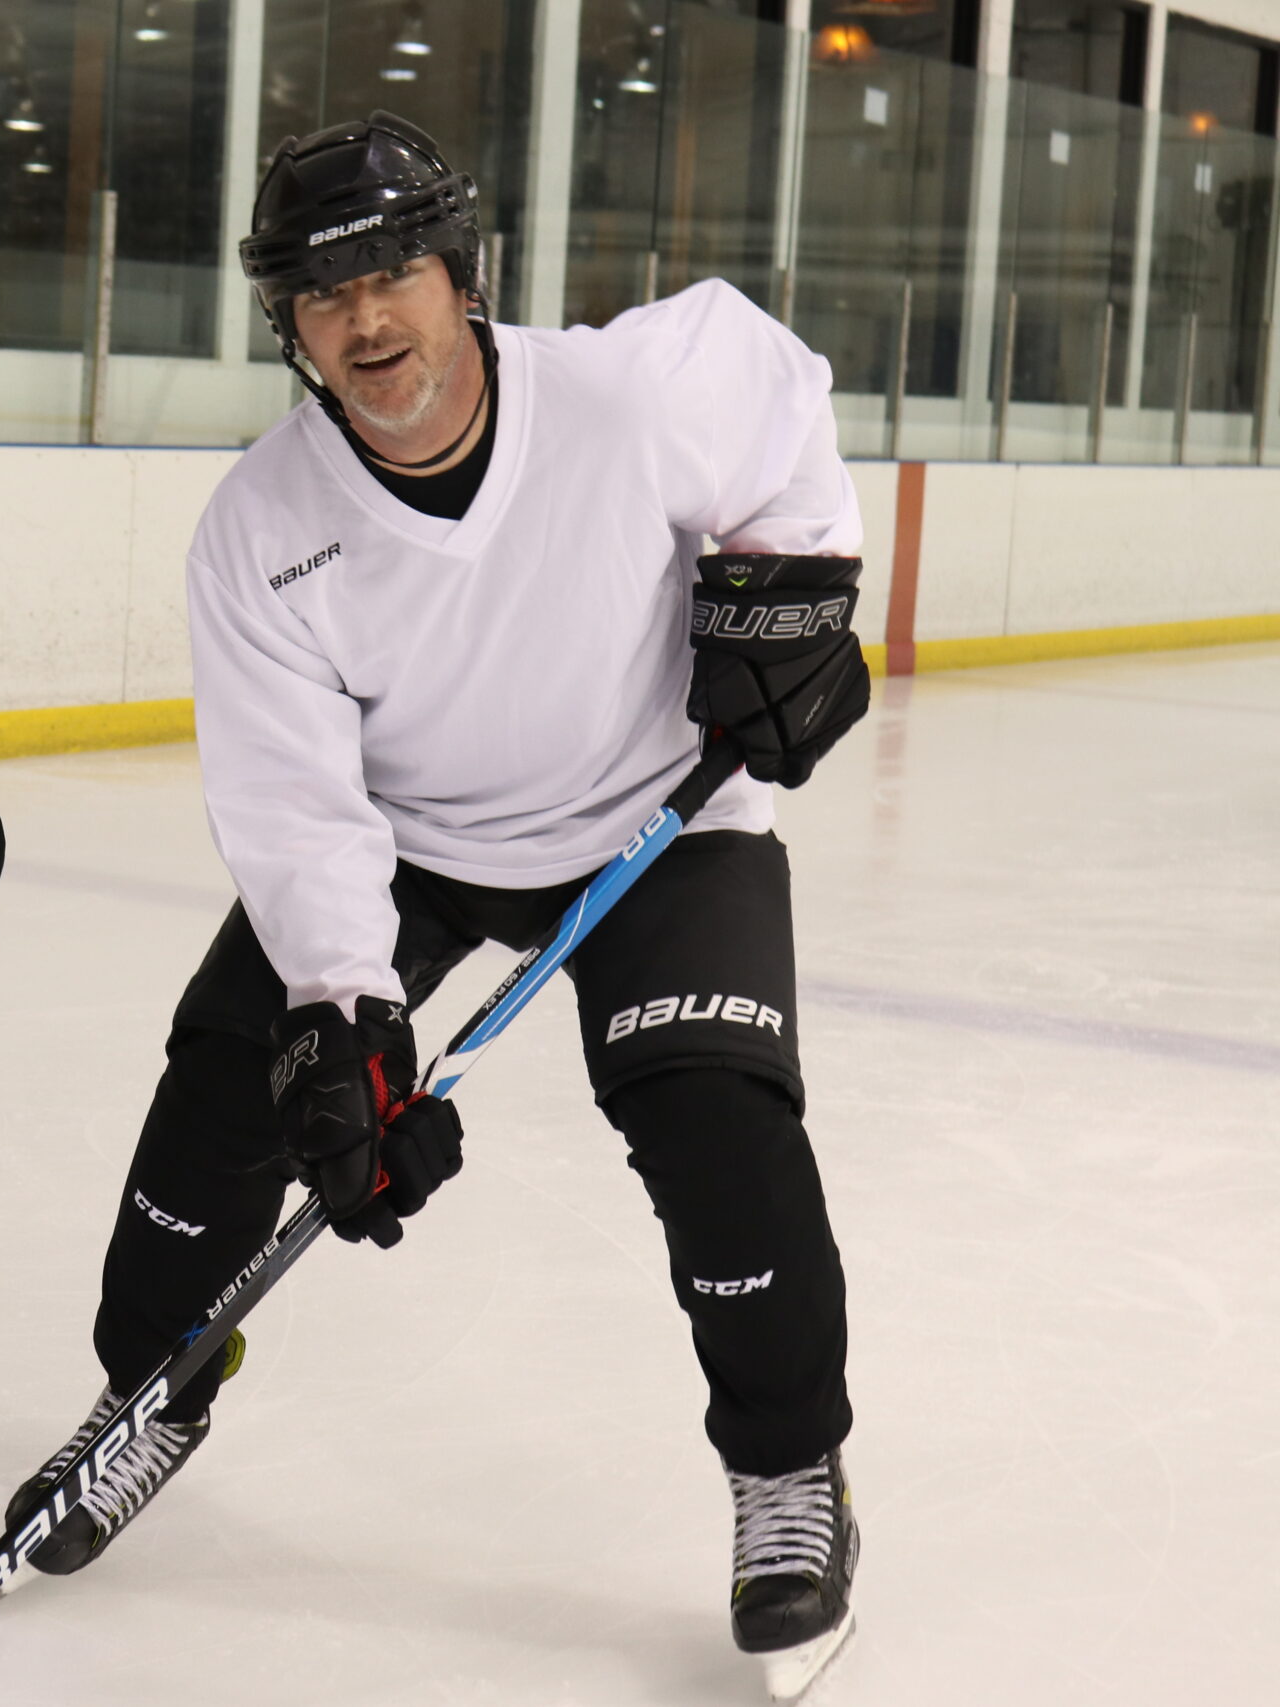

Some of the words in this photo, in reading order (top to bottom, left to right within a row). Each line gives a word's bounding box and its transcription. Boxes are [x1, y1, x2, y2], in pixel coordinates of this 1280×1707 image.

[308, 214, 383, 246] BAUER
[269, 542, 341, 590] BAUER
[606, 993, 784, 1045] BAUER
[134, 1188, 207, 1237] CCM
[206, 1233, 280, 1322] BAUER
[693, 1269, 774, 1296] CCM
